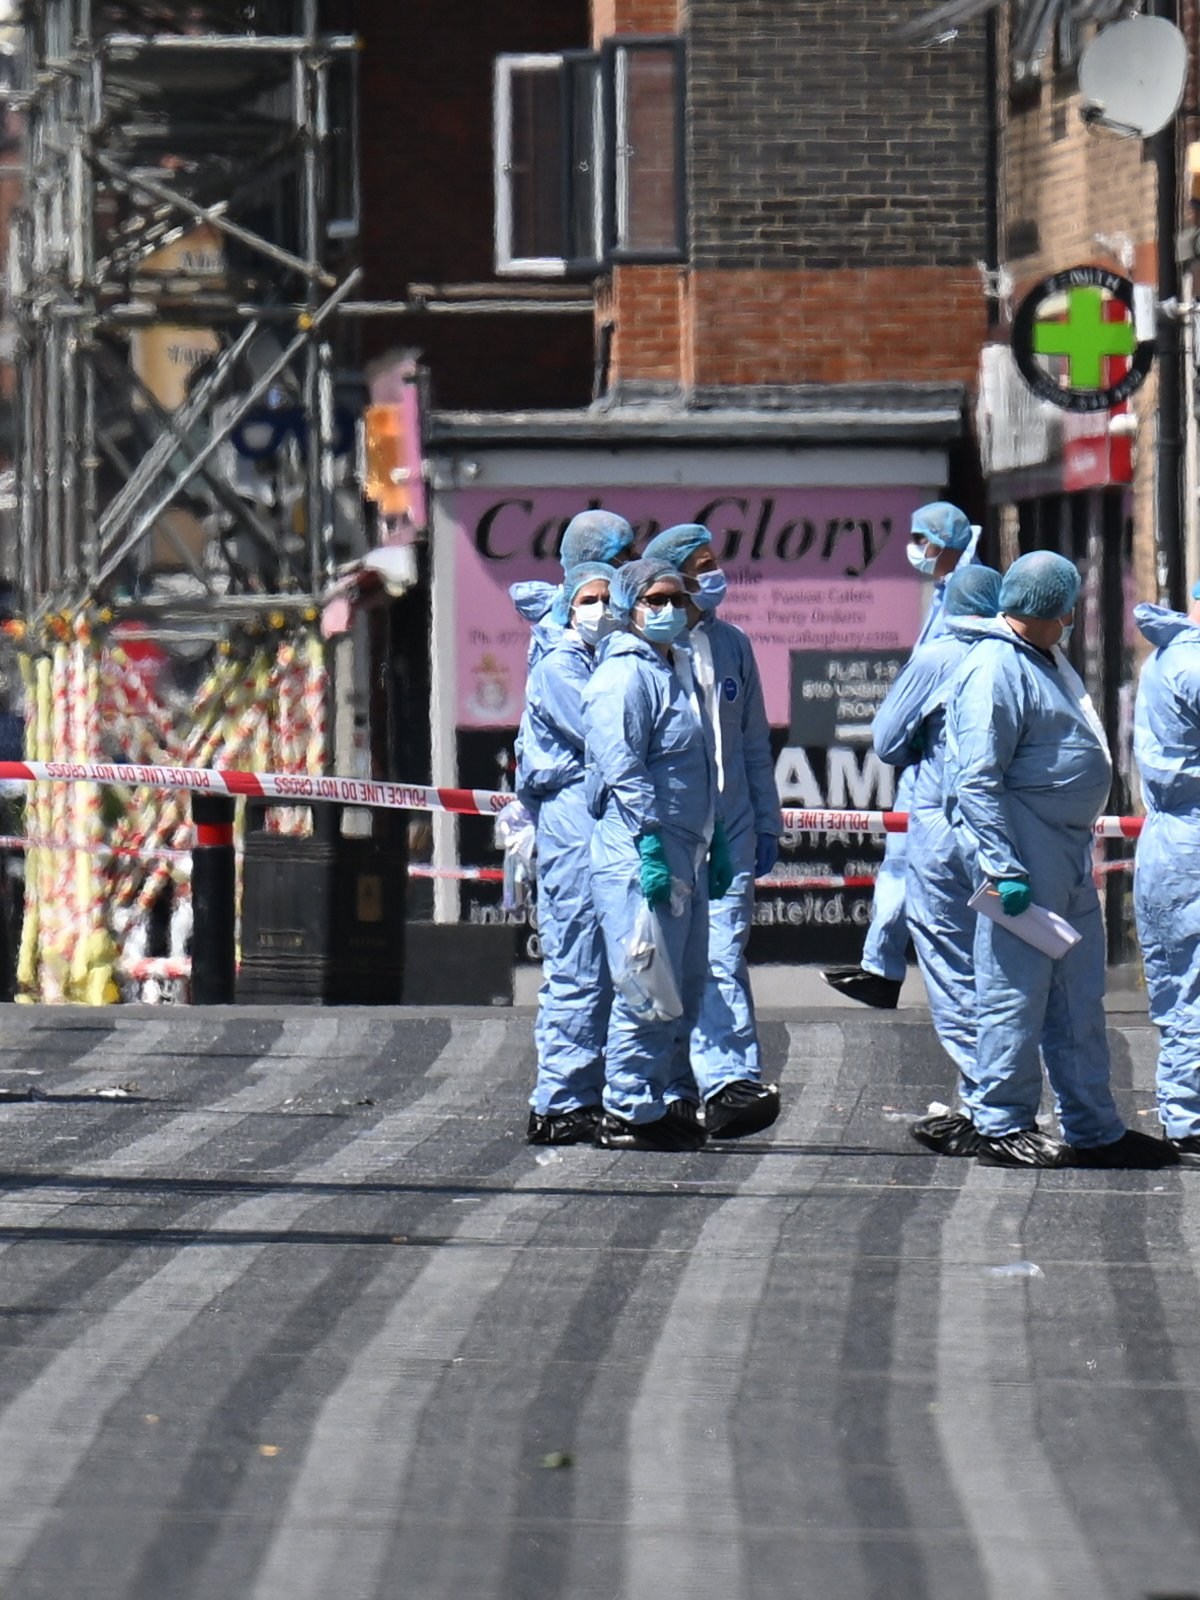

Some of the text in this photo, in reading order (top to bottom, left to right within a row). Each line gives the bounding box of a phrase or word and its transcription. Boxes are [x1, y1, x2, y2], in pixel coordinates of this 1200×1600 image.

[475, 496, 892, 578] Cae Glory
[837, 700, 881, 719] ROA
[47, 763, 211, 787] POLICE LINE DO NOT CROSS
[274, 776, 428, 807] POLICE LINE DO NOT CROSS
[797, 812, 825, 829] LINE
[827, 813, 872, 831] POLICE
